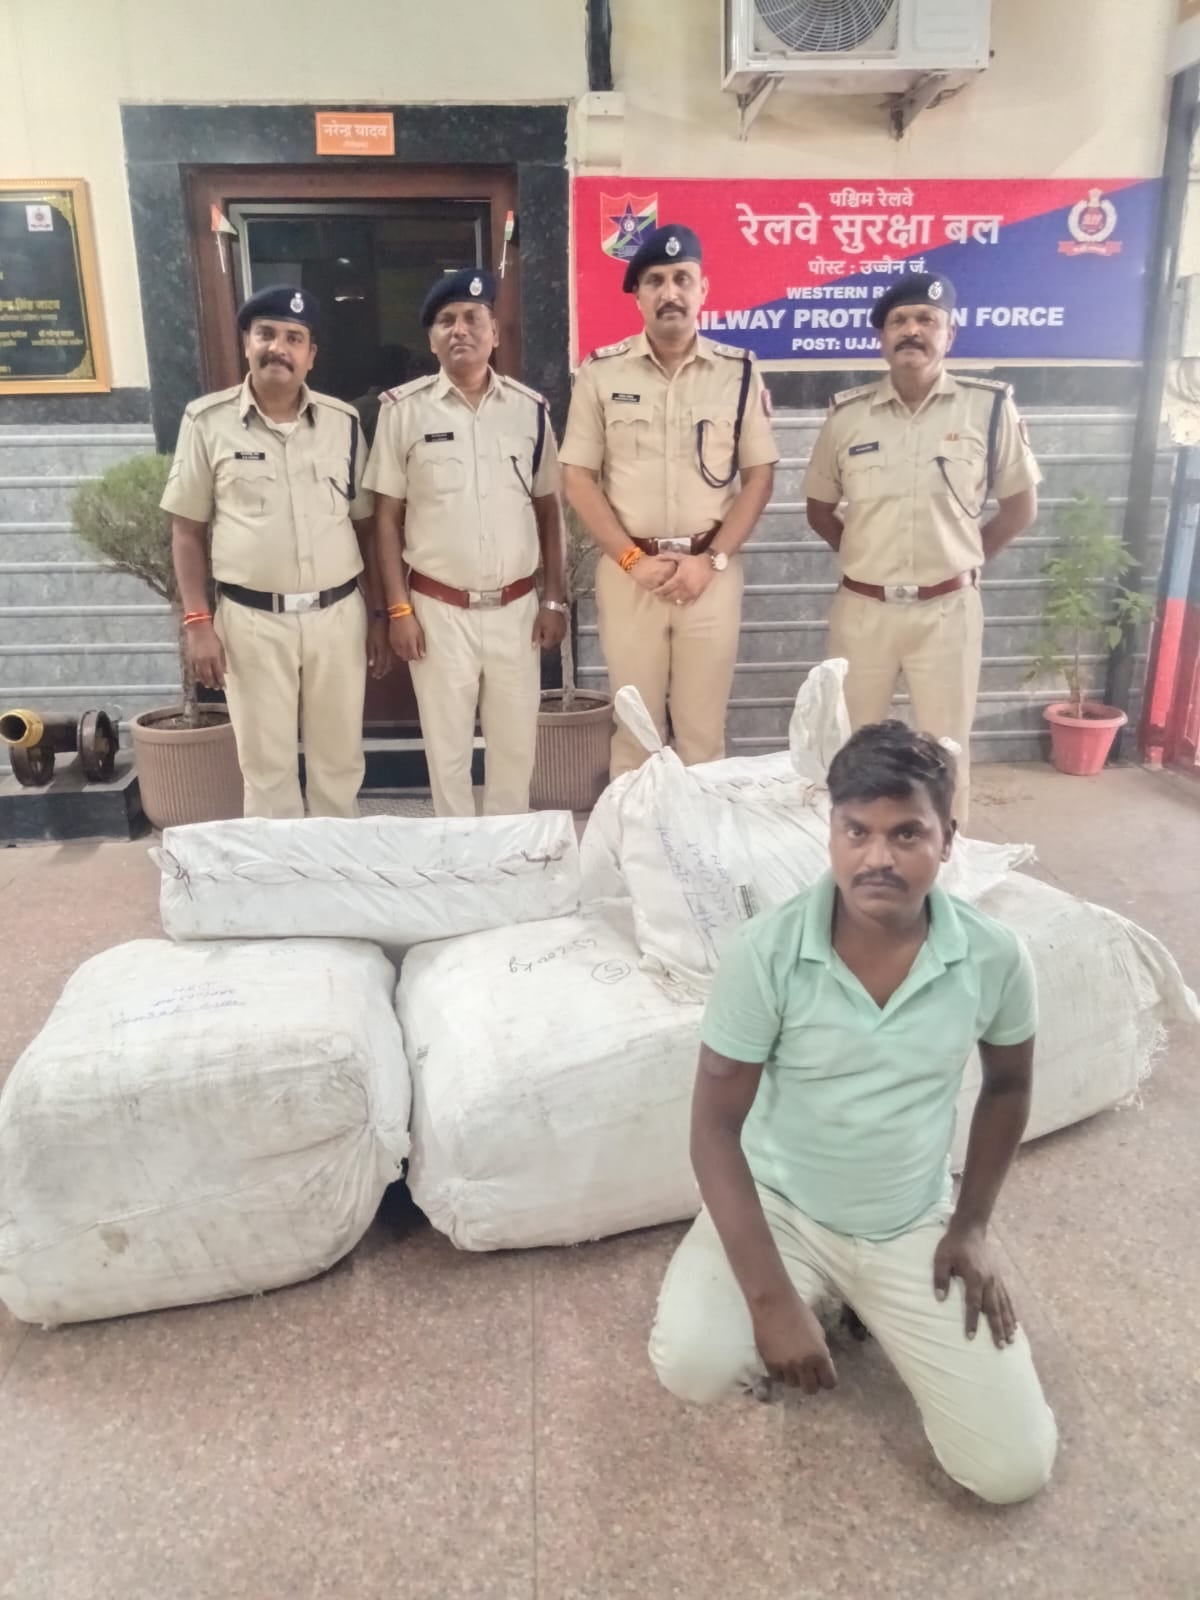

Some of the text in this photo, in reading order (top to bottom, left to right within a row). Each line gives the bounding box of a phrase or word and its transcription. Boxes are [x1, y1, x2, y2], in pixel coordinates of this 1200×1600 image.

[829, 187, 915, 207] पश्चिम रेलवे
[735, 203, 1004, 254] रेलवे सुरक्षा बल
[808, 255, 846, 275] पोस्ट
[786, 285, 868, 299] WESTERN
[696, 308, 786, 331] ILWAY
[976, 306, 1065, 327] FORCE
[791, 337, 882, 351] POST: UJJ
